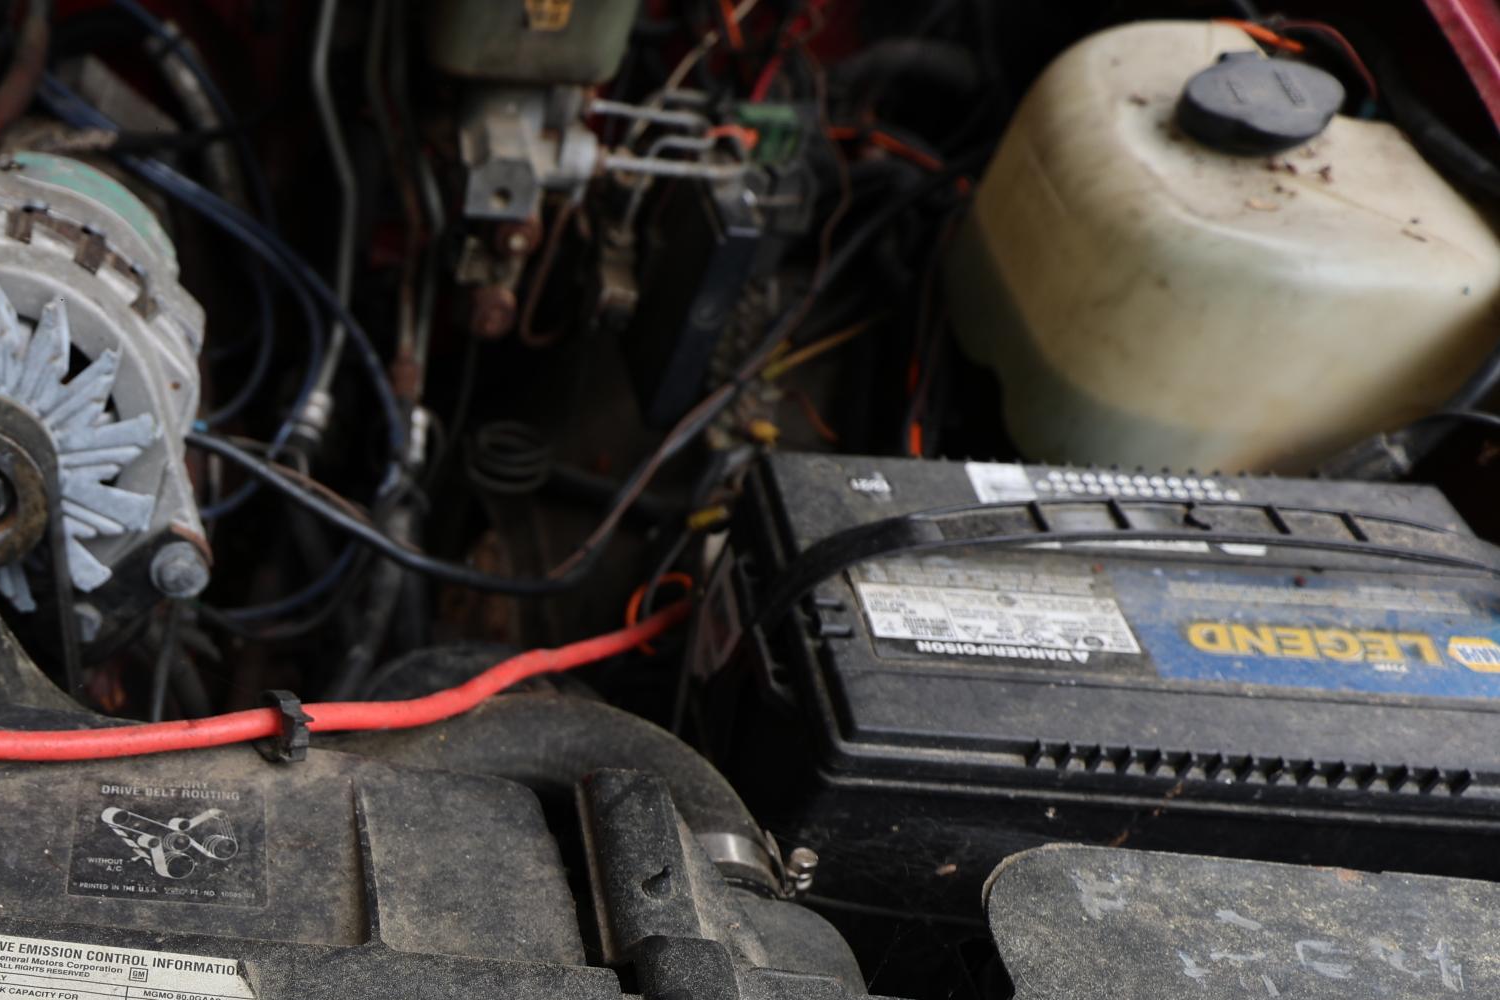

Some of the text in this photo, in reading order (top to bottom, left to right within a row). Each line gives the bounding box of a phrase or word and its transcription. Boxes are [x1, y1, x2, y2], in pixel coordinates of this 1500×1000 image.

[1187, 623, 1445, 667] LEGEND
[101, 784, 240, 801] DRIVE BELT ROUTING
[87, 856, 124, 866] WITHOUT
[79, 882, 109, 891] PRINTED
[123, 885, 136, 893] THE
[17, 942, 83, 959] EMISSION
[85, 950, 148, 966] CONTROL
[13, 964, 45, 973] RIGHTS
[45, 967, 90, 977] RESERVED
[30, 957, 63, 967] Motors
[66, 961, 123, 975] Corporation
[131, 970, 145, 978] GM
[8, 986, 56, 998] CAPACITY
[58, 991, 79, 1000] FOR
[142, 989, 174, 999] MGMO
